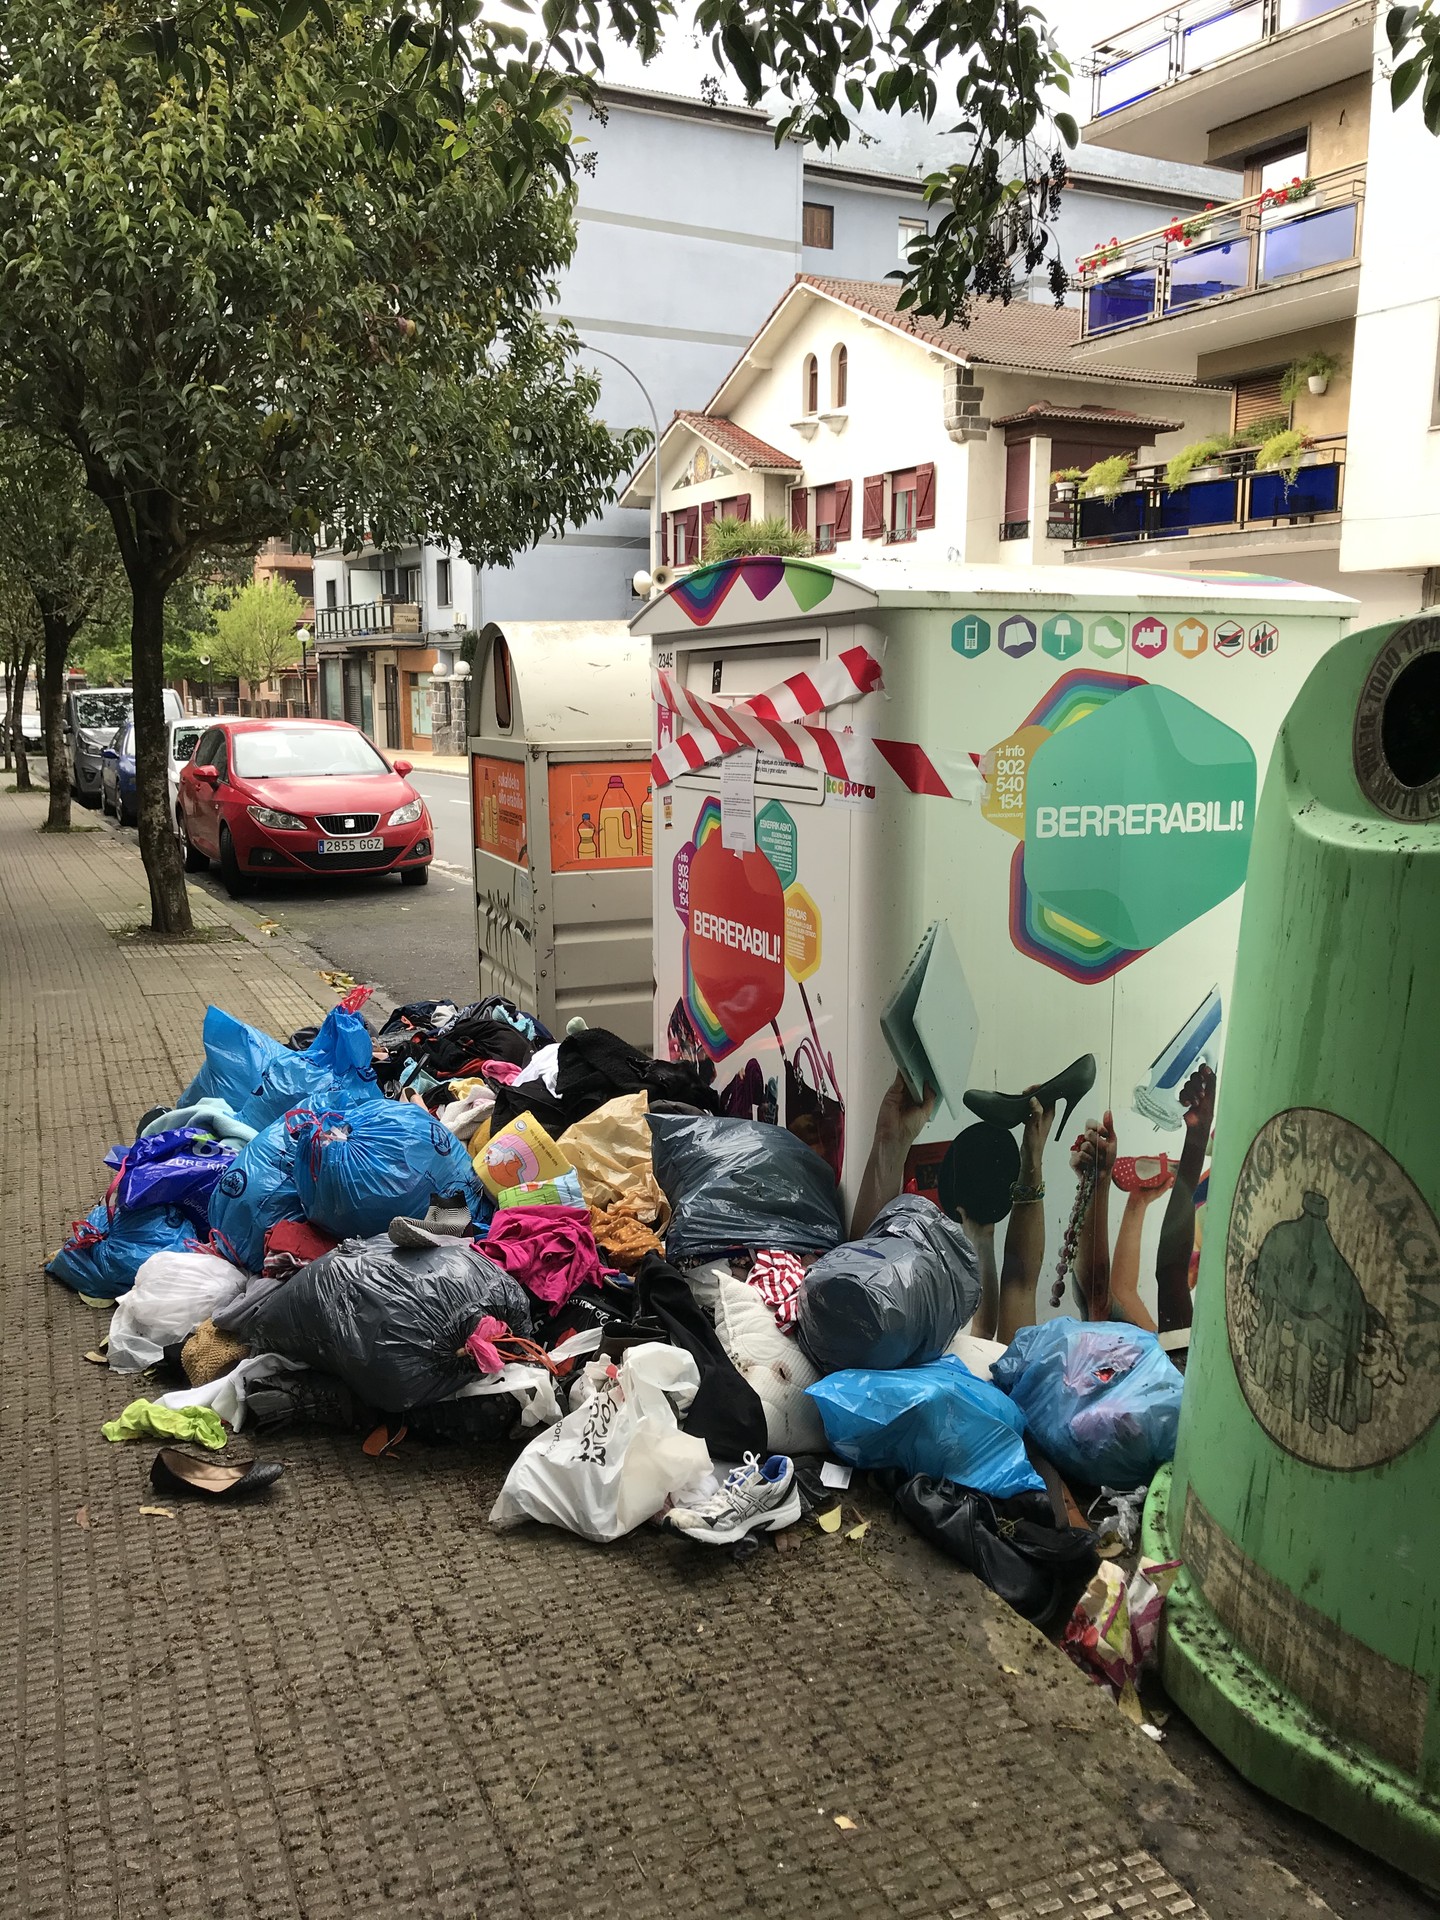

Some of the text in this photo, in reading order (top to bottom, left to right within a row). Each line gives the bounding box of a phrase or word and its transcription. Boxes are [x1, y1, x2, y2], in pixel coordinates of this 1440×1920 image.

[658, 652, 673, 669] 2345
[1005, 745, 1025, 757] info
[997, 759, 1025, 775] 902
[826, 776, 876, 800] koopera
[996, 776, 1025, 792] 540
[999, 793, 1023, 809] 154
[1035, 800, 1245, 838] BERRERABILI!
[325, 838, 382, 852] 2855 GGZ
[677, 863, 689, 878] 902
[677, 878, 689, 893] 540
[679, 892, 689, 907] 154
[693, 909, 781, 964] BERRERABILI!
[165, 1156, 204, 1168] ZURE
